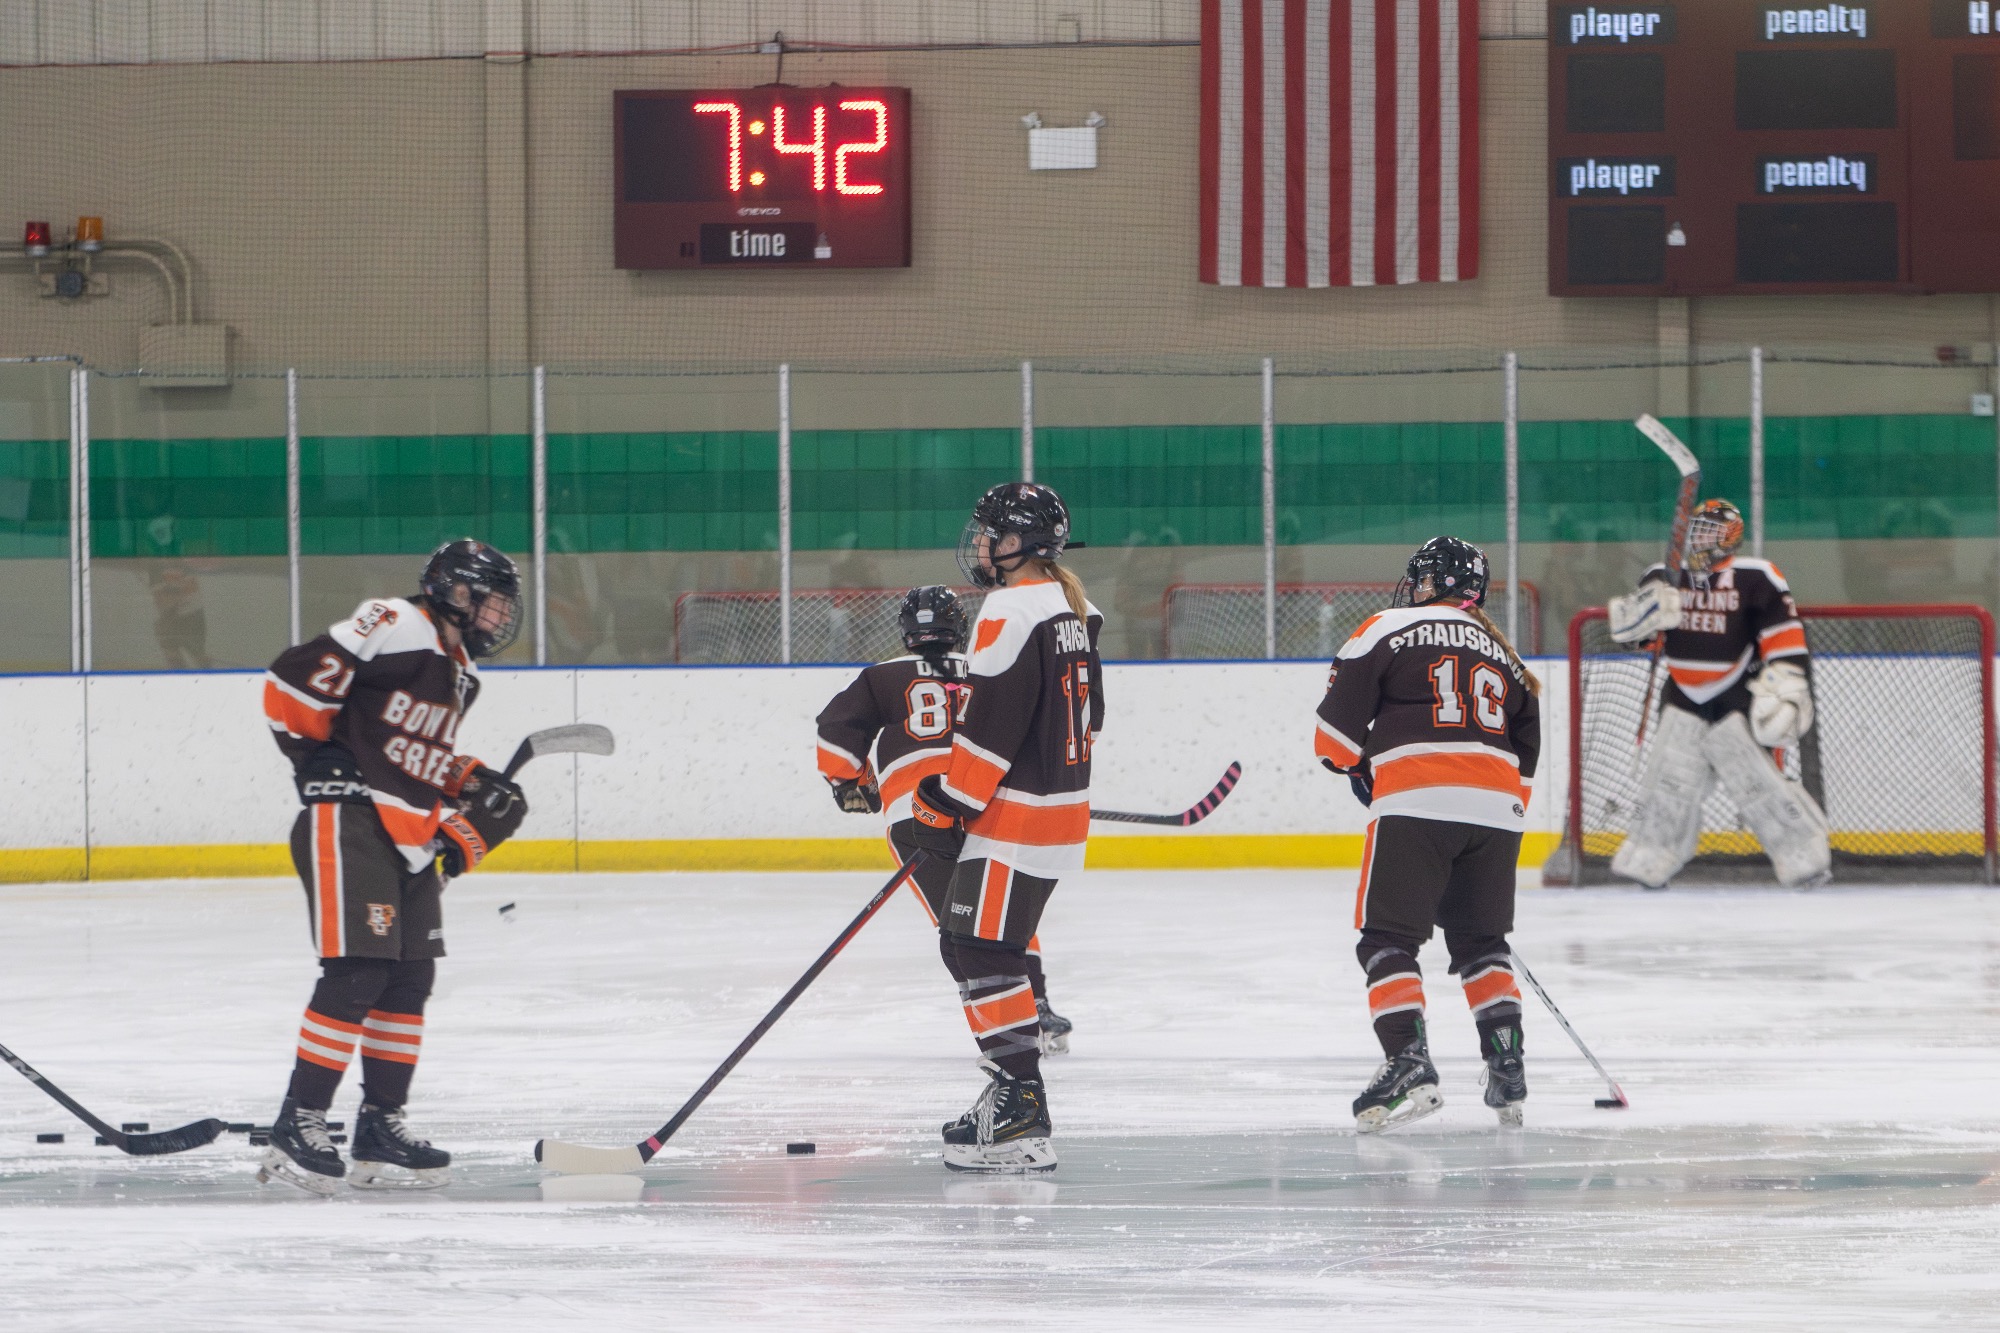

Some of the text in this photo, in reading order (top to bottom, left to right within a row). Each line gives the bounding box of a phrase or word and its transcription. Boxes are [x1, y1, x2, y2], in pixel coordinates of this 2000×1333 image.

[1570, 7, 1660, 43] player
[1765, 4, 1867, 39] penalty
[692, 101, 888, 195] 7:42
[1570, 159, 1660, 196] player
[1765, 156, 1867, 192] penalty
[730, 230, 786, 257] time
[1680, 589, 1740, 613] WLING
[1679, 611, 1727, 634] REEN
[306, 652, 357, 698] 21
[904, 679, 975, 742] 87
[303, 781, 370, 797] CCM
